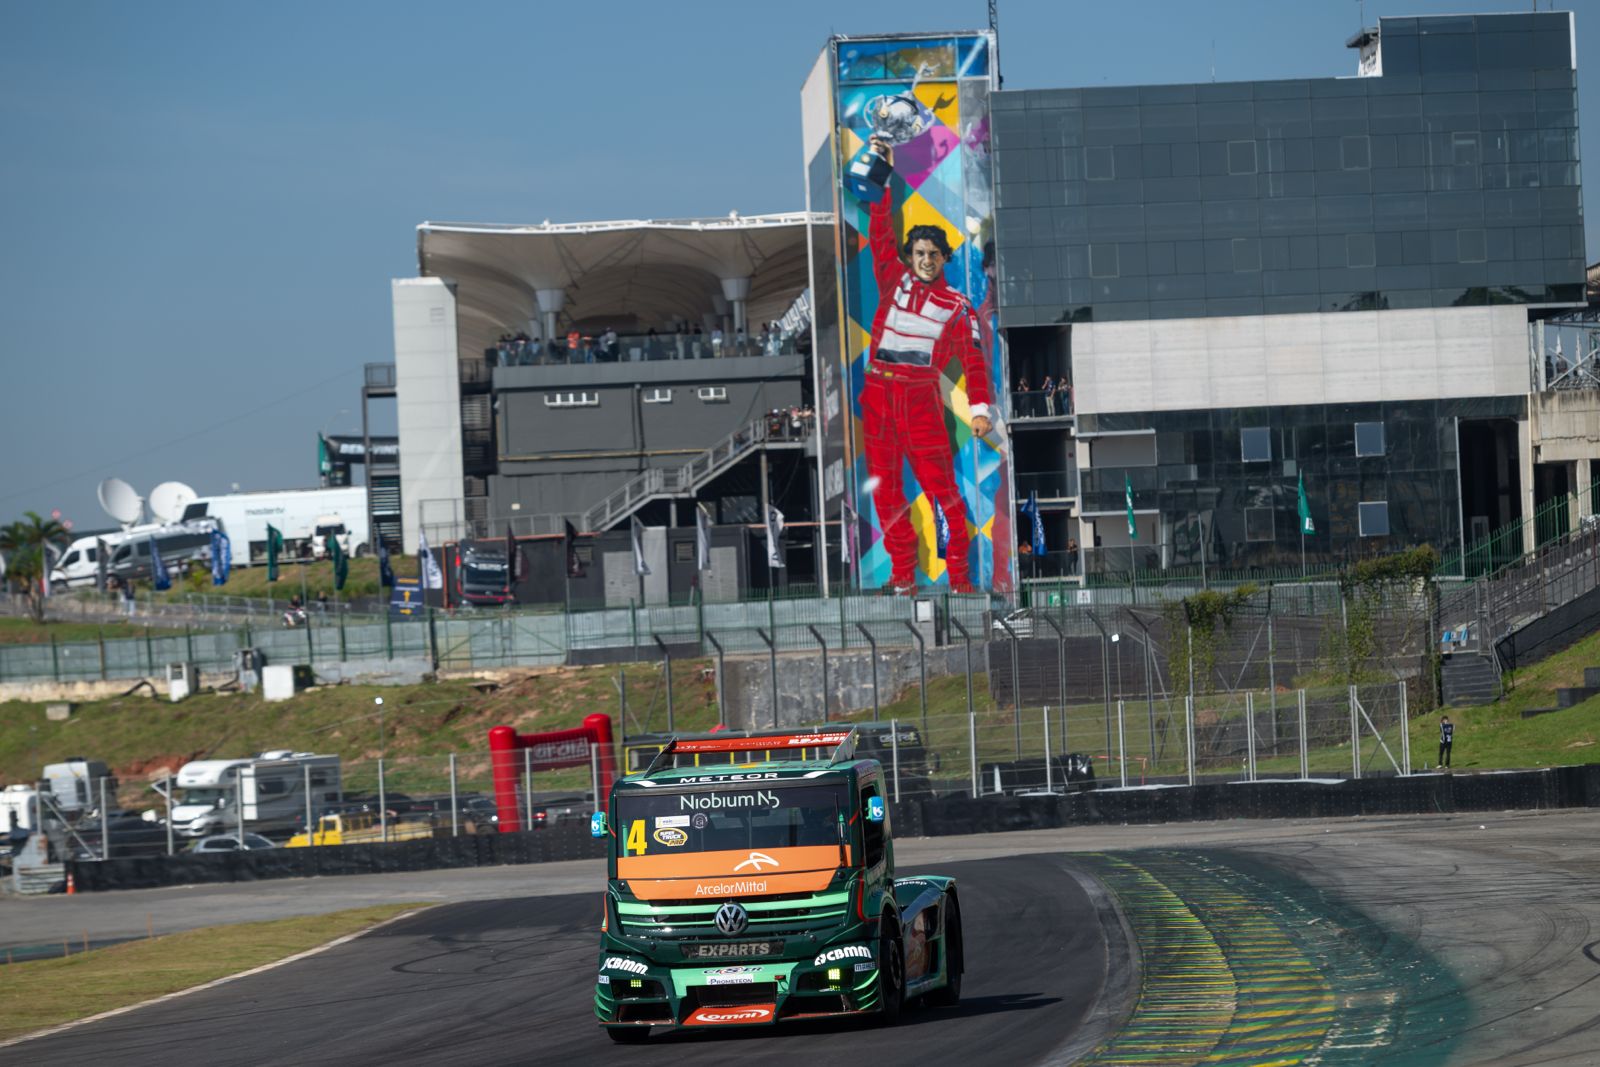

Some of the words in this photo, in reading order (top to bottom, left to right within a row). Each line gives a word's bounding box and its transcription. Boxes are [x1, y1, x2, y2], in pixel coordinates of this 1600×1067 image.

[680, 772, 778, 783] METEOR
[680, 793, 754, 810] Niobium
[627, 820, 647, 855] 4
[695, 881, 767, 896] ArcelorMittal
[698, 943, 770, 957] EXPARTS
